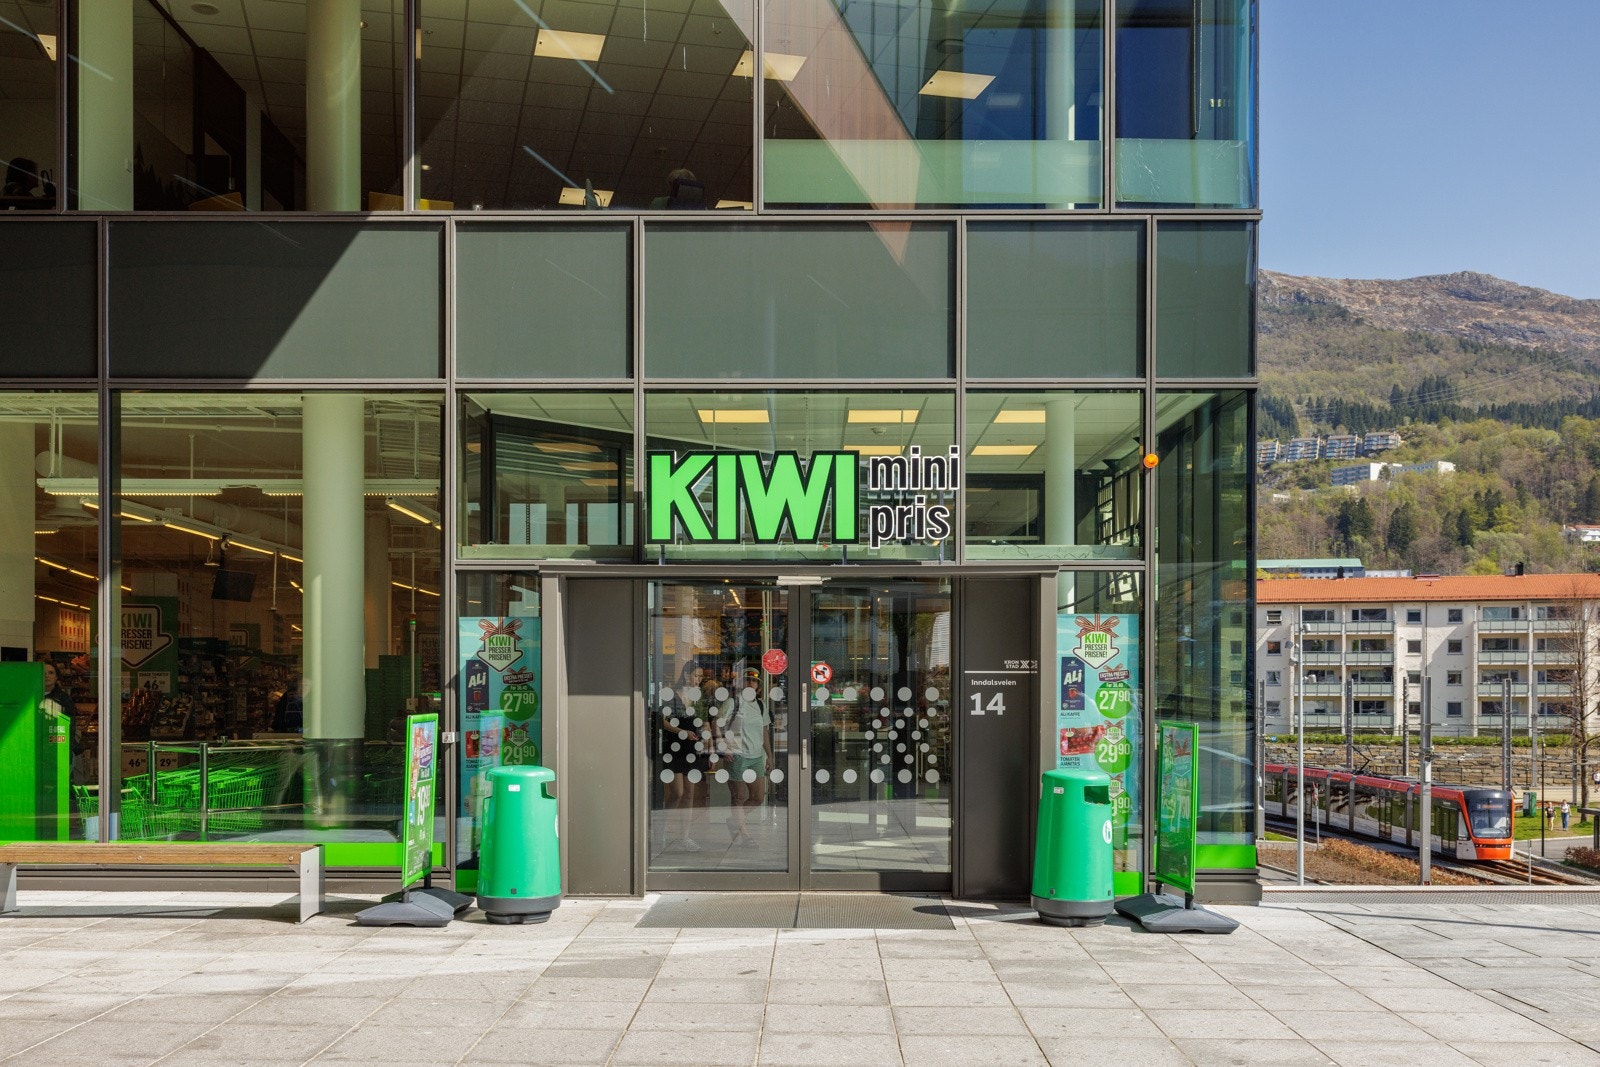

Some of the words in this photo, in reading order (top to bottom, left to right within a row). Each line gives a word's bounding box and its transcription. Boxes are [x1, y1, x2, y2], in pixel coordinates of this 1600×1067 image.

[870, 445, 960, 490] mini
[647, 450, 859, 544] KIWI
[869, 495, 951, 549] pris
[489, 637, 511, 646] KIWI
[1085, 633, 1107, 643] KIWI
[970, 692, 1006, 716] 14
